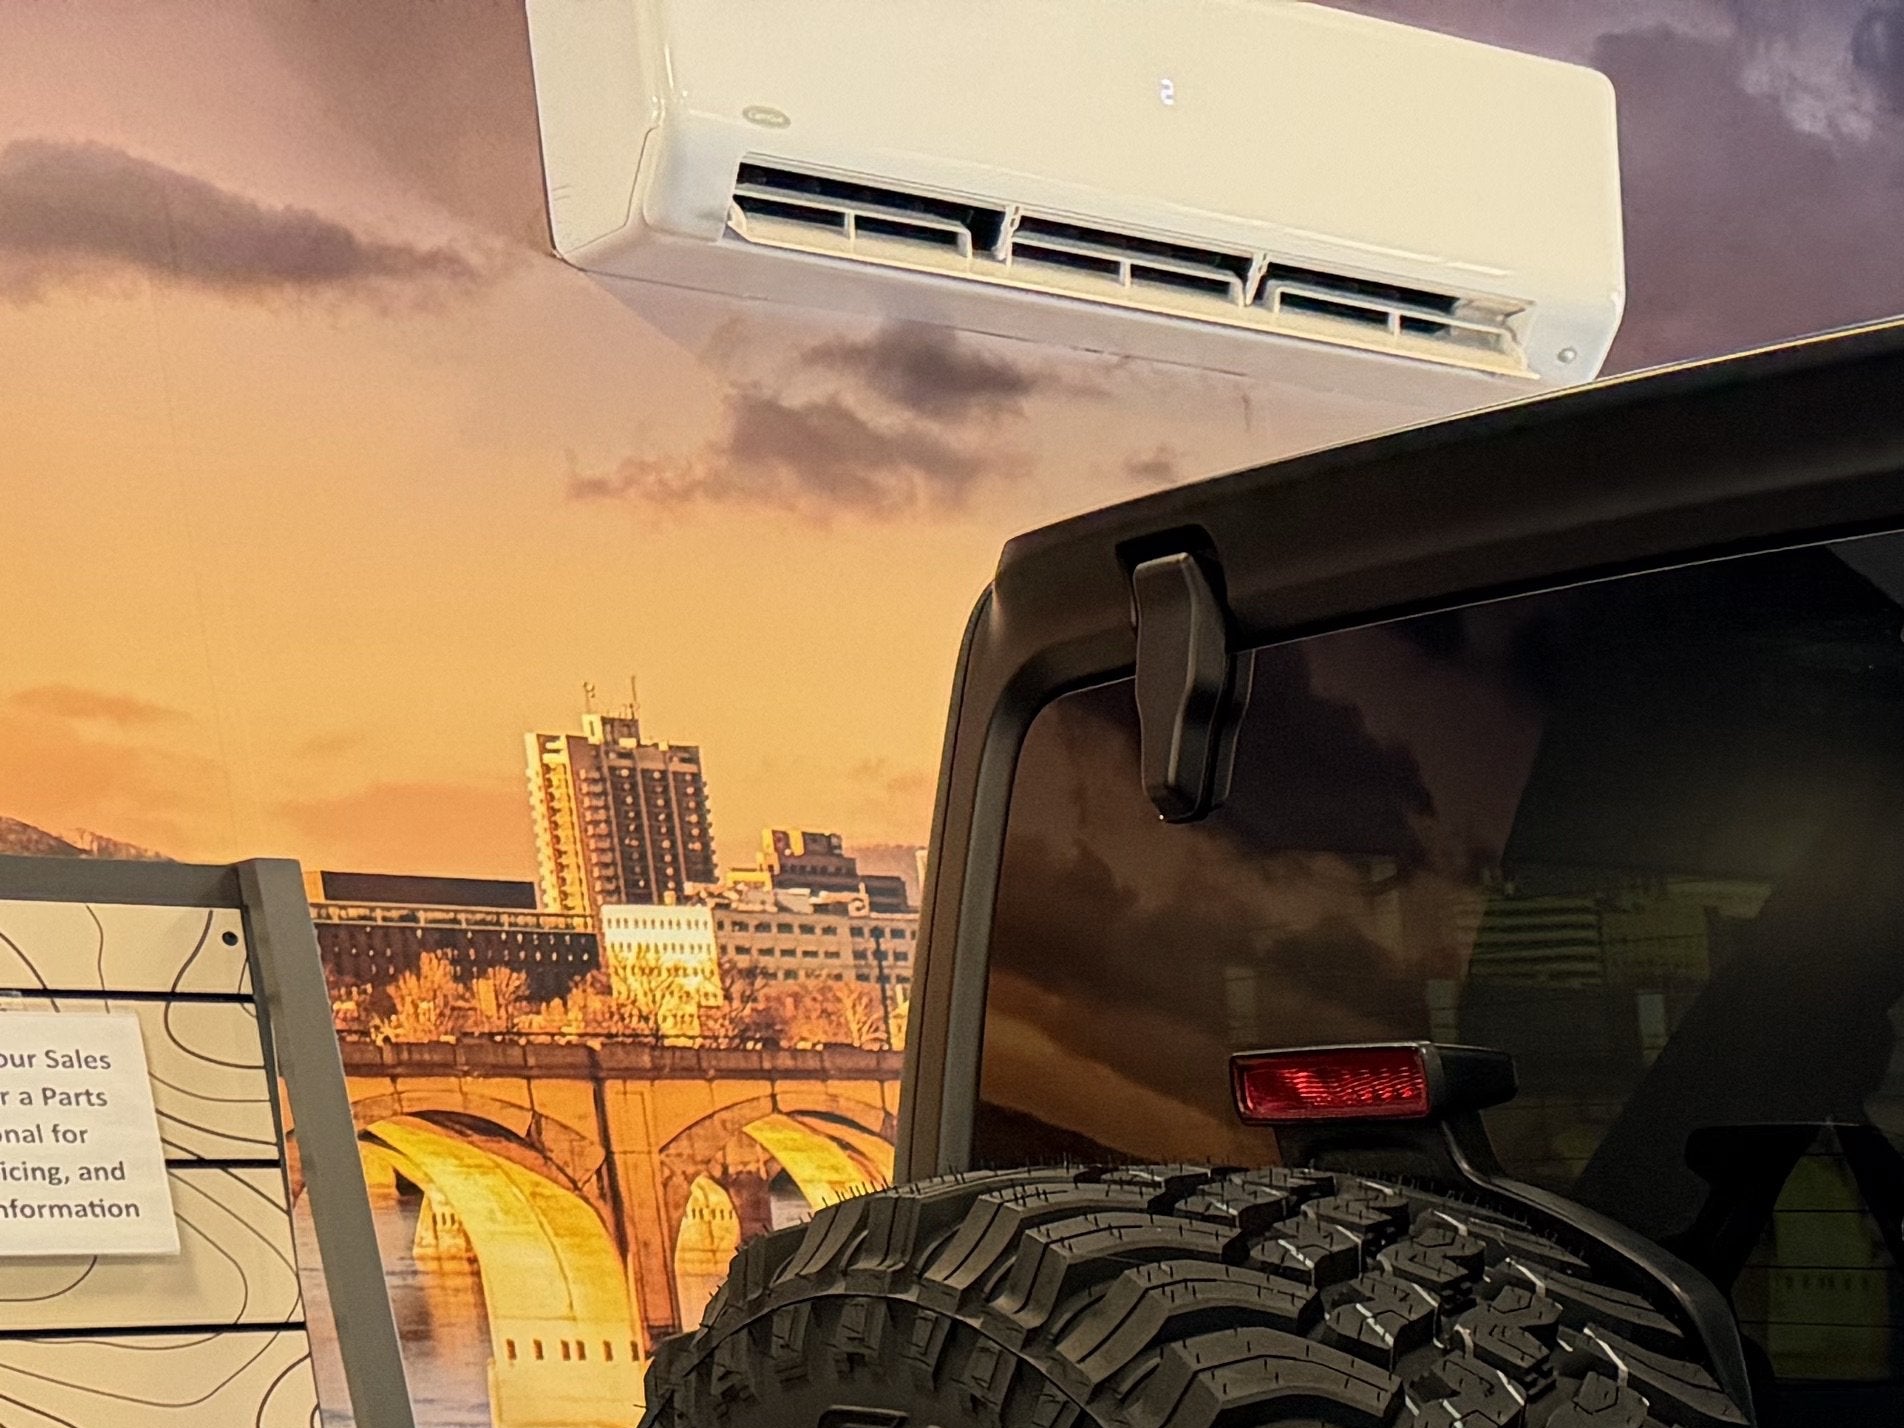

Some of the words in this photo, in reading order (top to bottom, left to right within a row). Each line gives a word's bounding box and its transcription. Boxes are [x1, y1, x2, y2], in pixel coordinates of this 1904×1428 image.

[44, 1049, 111, 1069] Sales
[18, 1090, 33, 1106] a
[41, 1087, 108, 1107] Parts
[0, 1123, 43, 1143] nal
[51, 1123, 88, 1144] for
[78, 1160, 126, 1181] and
